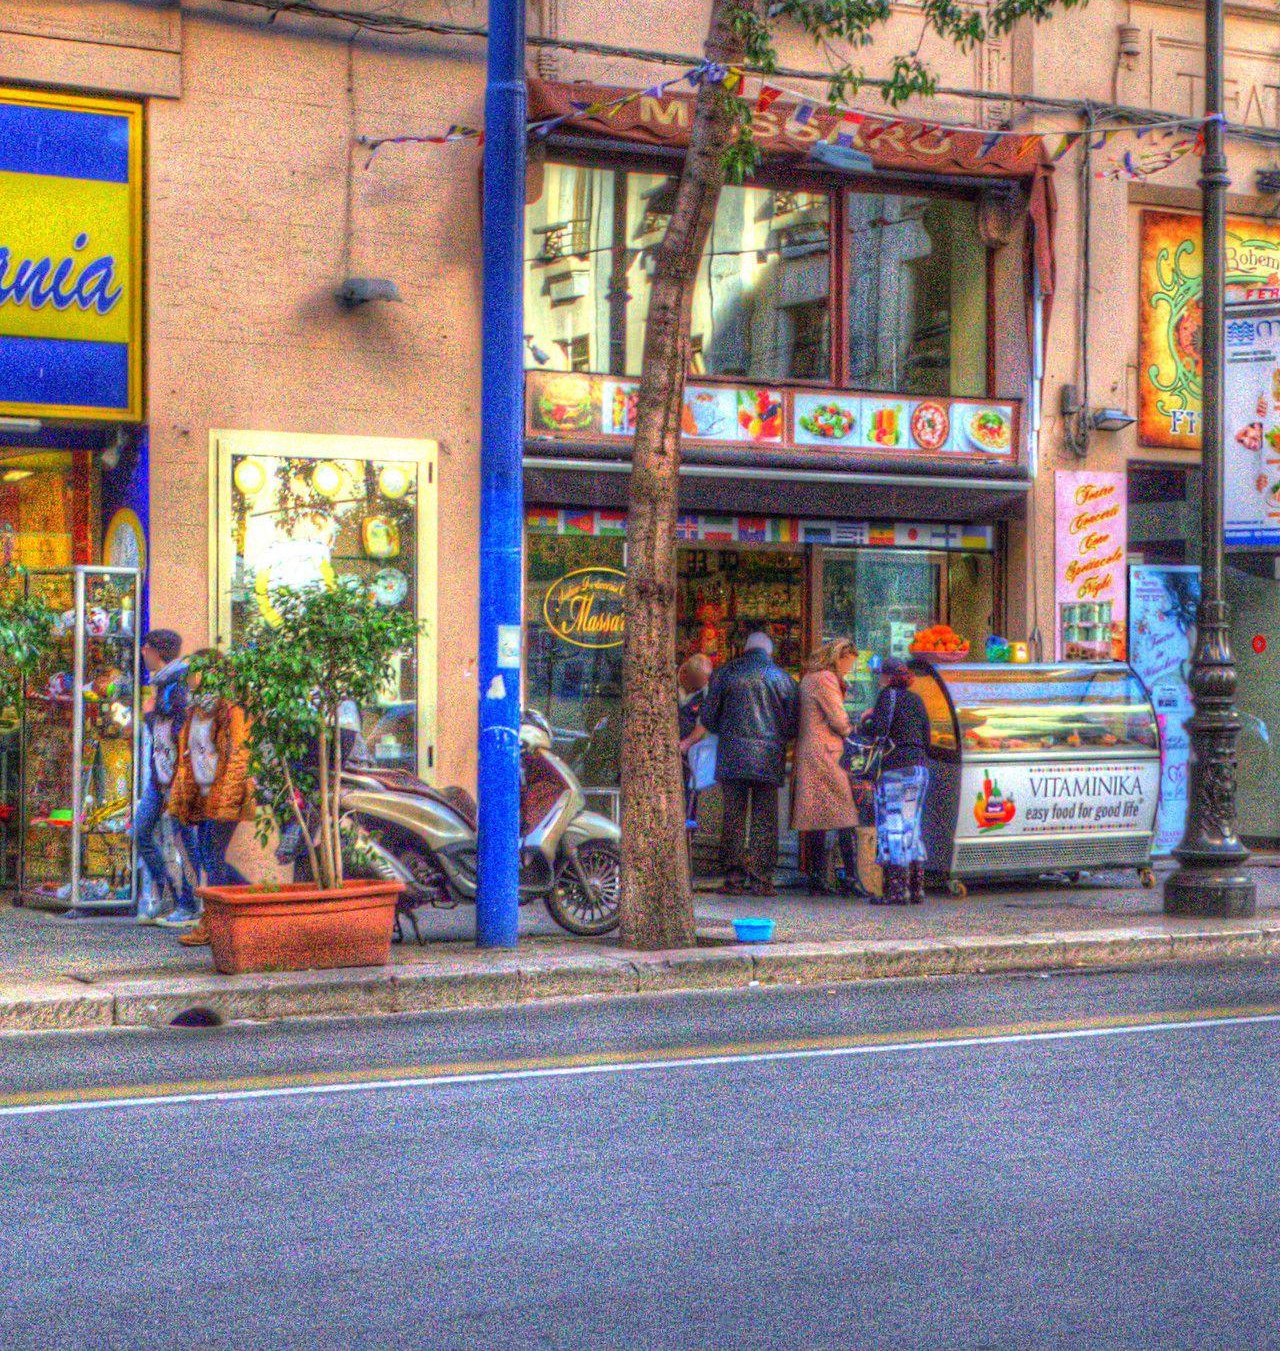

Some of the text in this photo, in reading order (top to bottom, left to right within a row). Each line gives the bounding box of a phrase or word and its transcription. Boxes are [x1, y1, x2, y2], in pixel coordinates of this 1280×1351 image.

[640, 98, 950, 155] MSSARO
[1029, 775, 1143, 797] VITAMINIKA
[1025, 807, 1048, 822] easy
[1051, 803, 1075, 819] food
[1077, 803, 1093, 818] for
[1095, 801, 1120, 821] good
